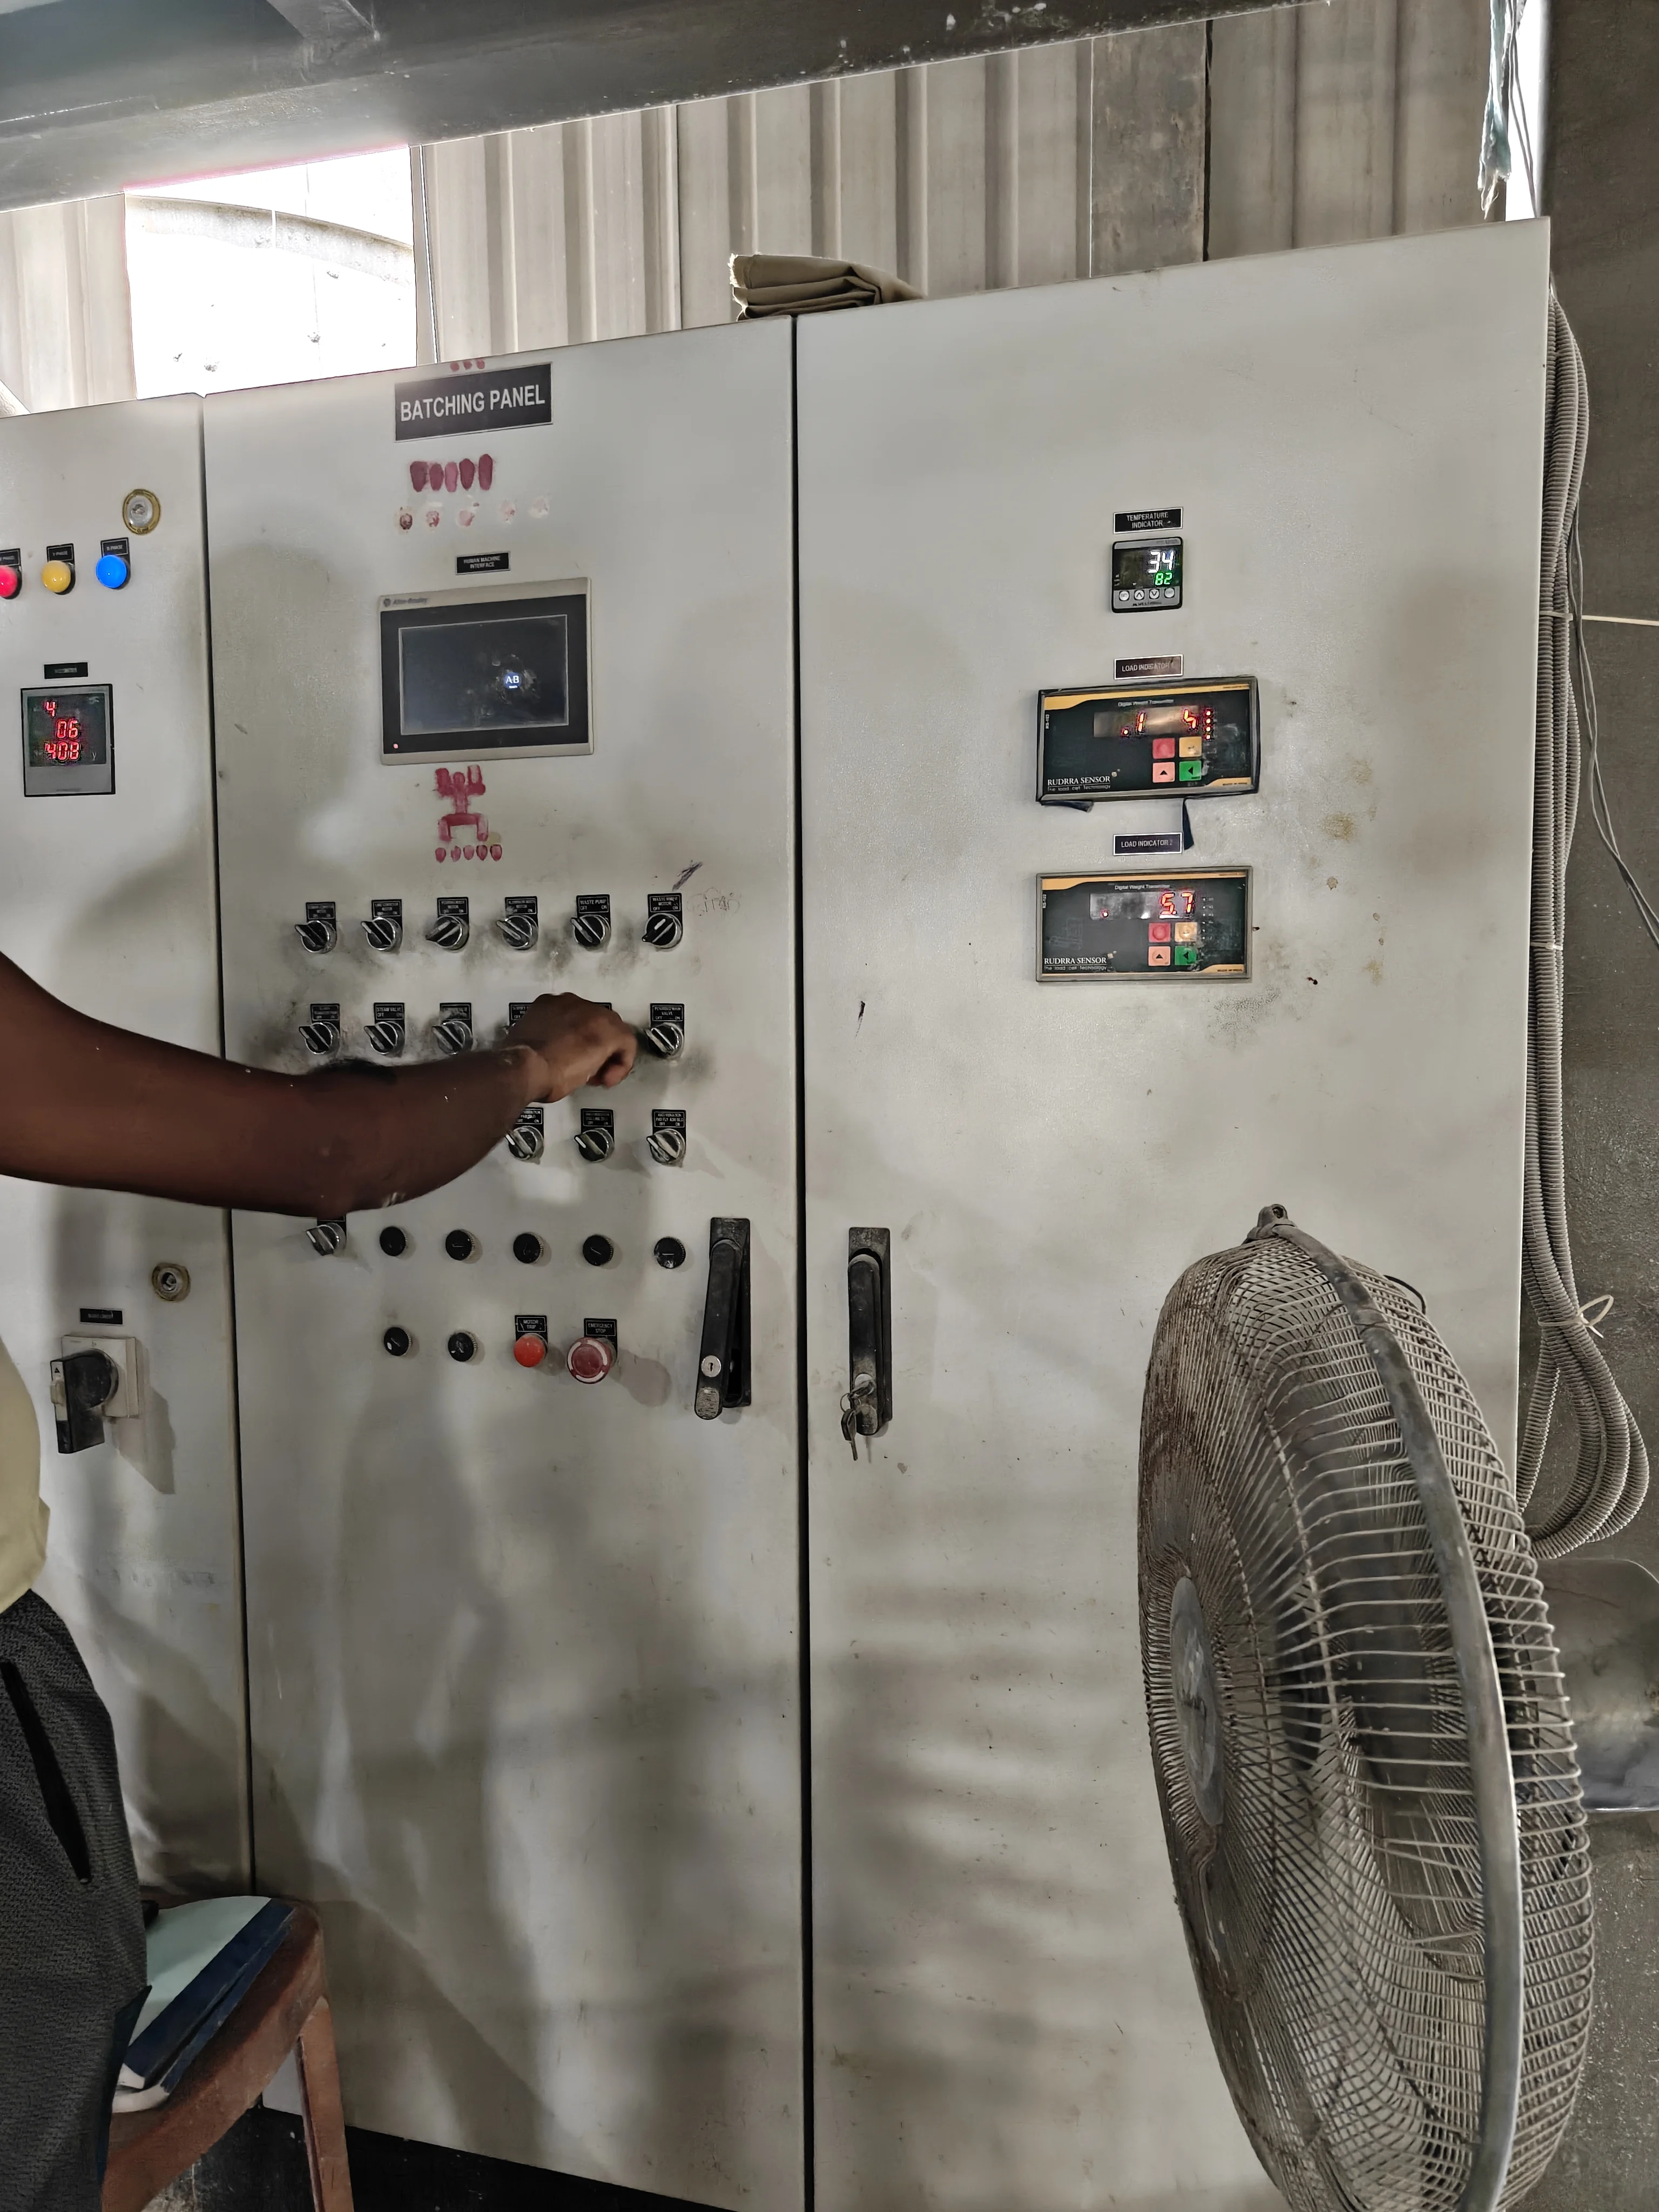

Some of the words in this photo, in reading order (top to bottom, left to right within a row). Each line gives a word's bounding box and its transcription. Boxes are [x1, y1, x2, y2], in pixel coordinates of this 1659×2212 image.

[401, 392, 484, 421] BATCHING
[490, 385, 545, 410] PANEL
[1127, 512, 1169, 521] TEMPERATURE
[1132, 520, 1163, 529] INDICATOR
[1148, 551, 1174, 574] 34
[1155, 572, 1172, 585] 82
[506, 675, 520, 684] AB
[1048, 778, 1079, 786] RUDRRA
[1081, 776, 1110, 784] SENSOR
[1138, 839, 1168, 847] INDICATOR
